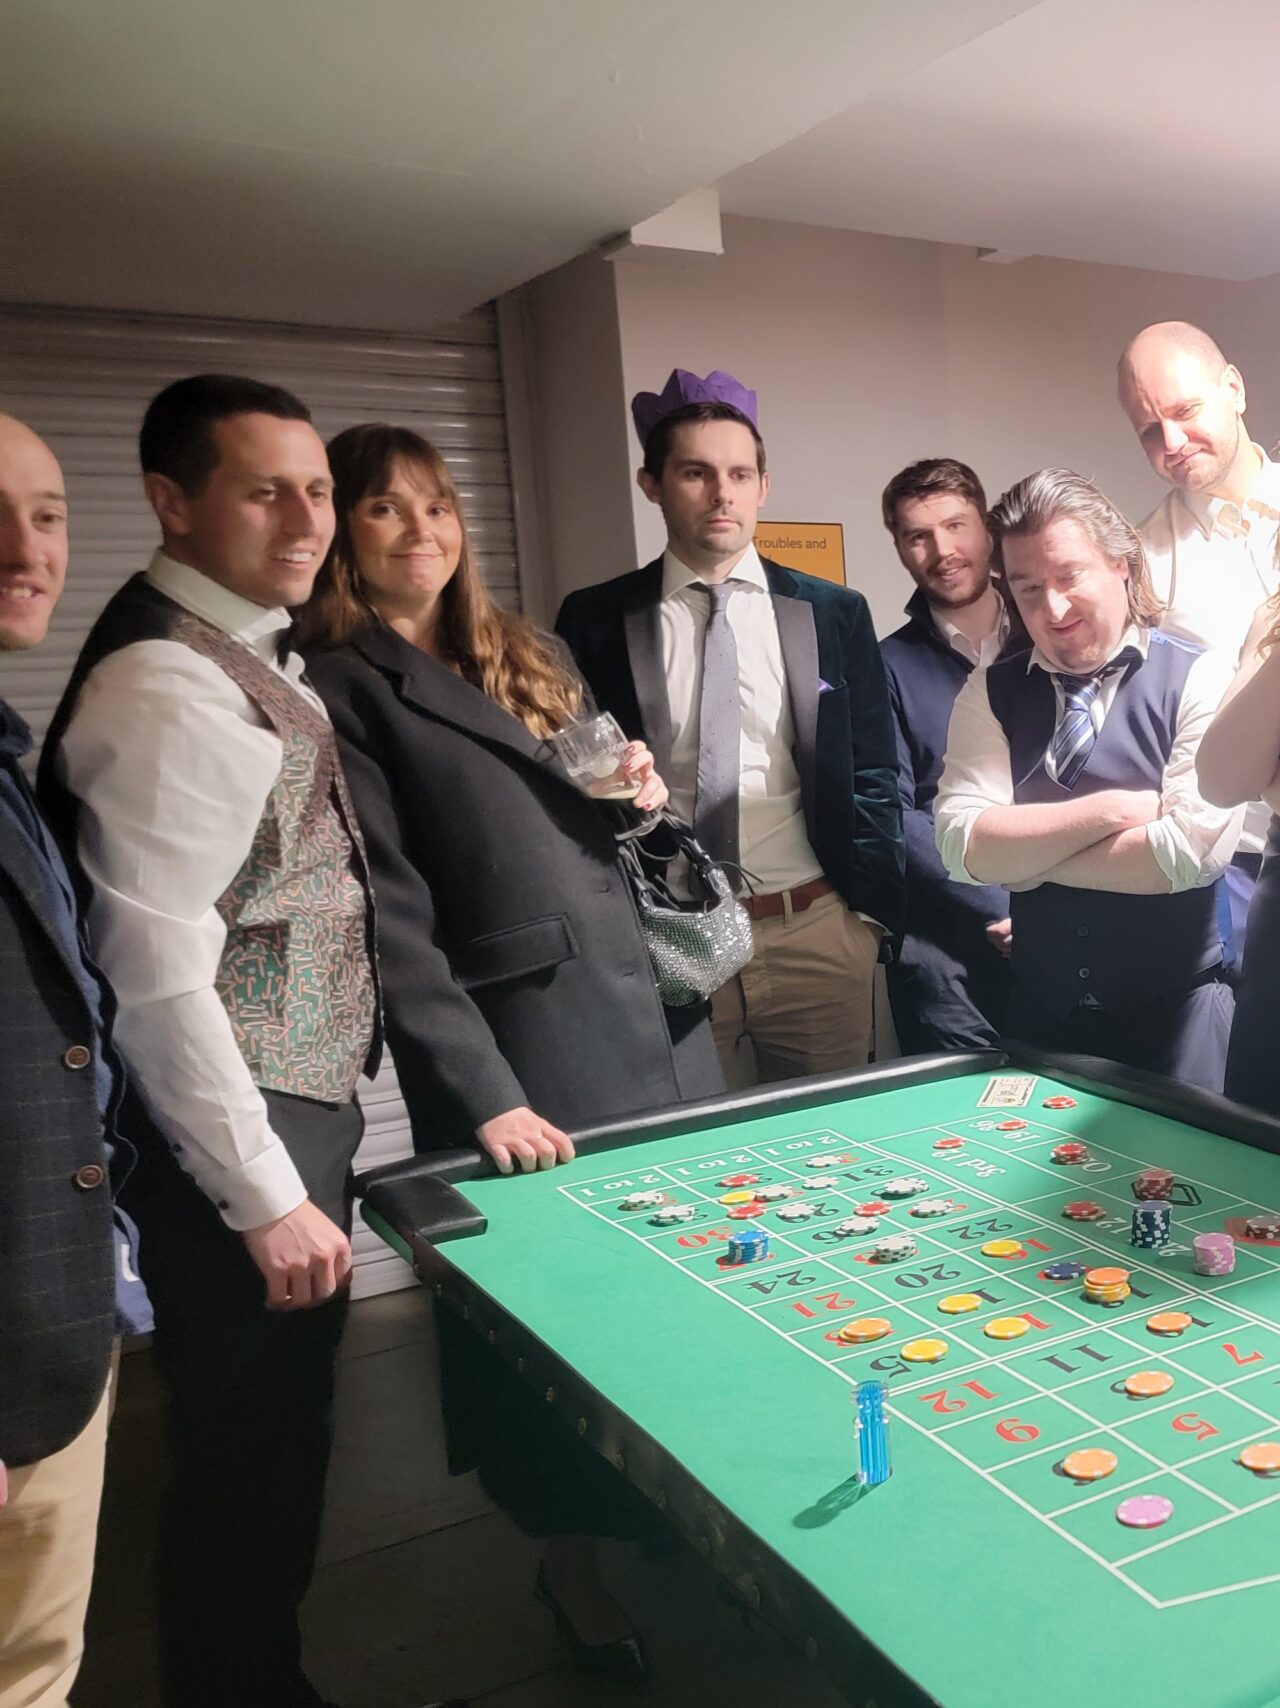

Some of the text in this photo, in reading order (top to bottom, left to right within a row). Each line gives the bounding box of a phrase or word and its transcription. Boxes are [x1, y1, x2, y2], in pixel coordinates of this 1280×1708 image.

[805, 538, 827, 549] and
[764, 1135, 838, 1157] 2 to 1
[674, 1154, 753, 1176] 2 to 1
[840, 1165, 894, 1182] 31
[961, 1157, 1006, 1178] 3rd
[579, 1174, 661, 1197] 2 to 1
[947, 1218, 1014, 1240] 22
[744, 1270, 816, 1295] 24
[895, 1263, 961, 1288] 20
[784, 1292, 856, 1319] 21
[1037, 1344, 1114, 1374] 11
[1222, 1343, 1264, 1367] 7
[918, 1379, 1002, 1414] 12
[994, 1417, 1041, 1443] 9
[1171, 1412, 1220, 1441] 5
